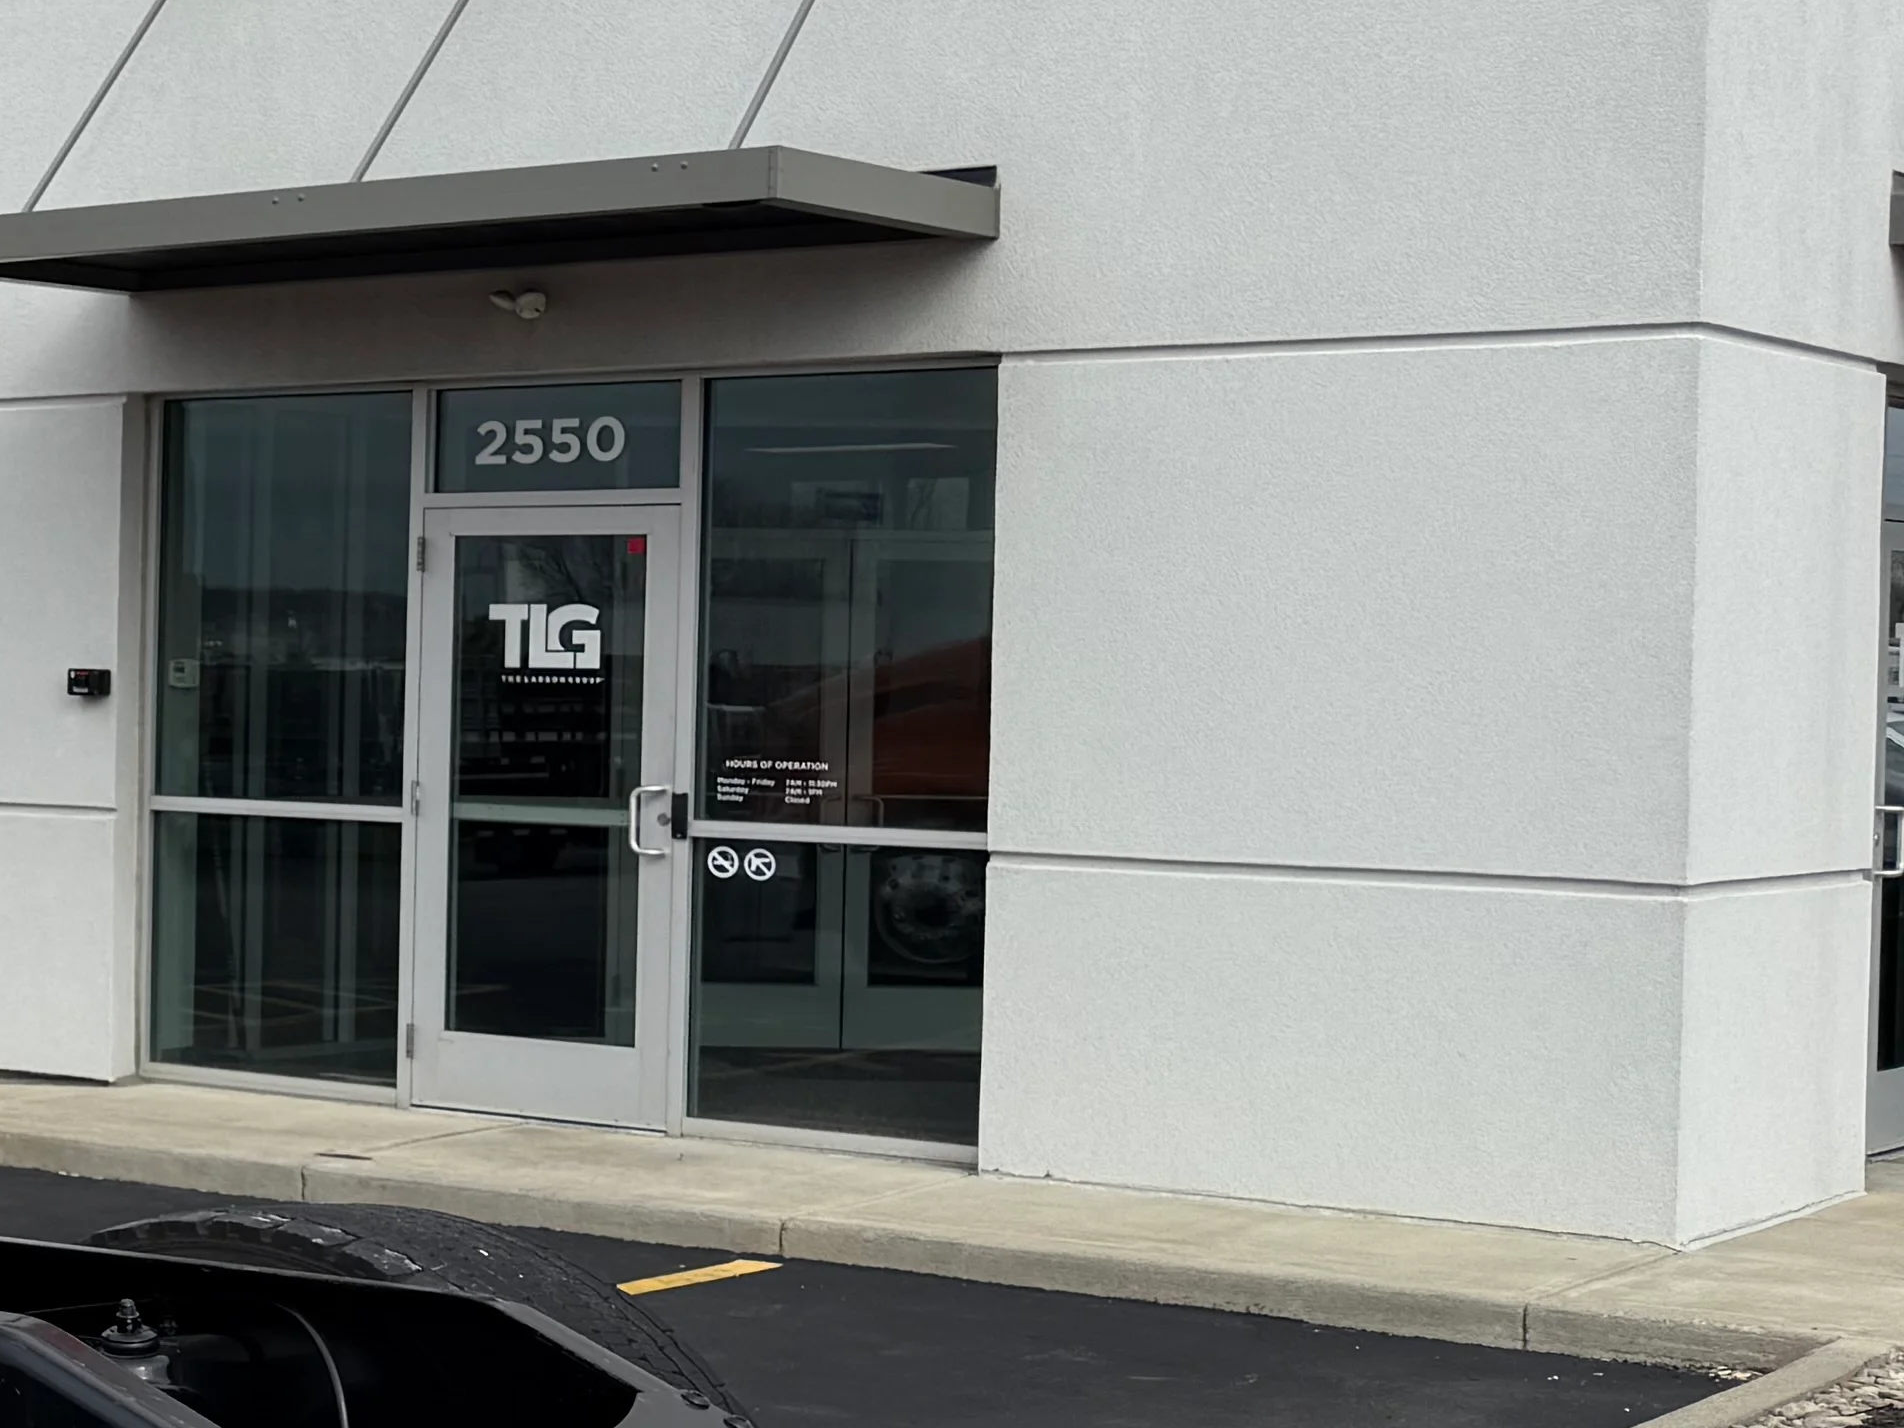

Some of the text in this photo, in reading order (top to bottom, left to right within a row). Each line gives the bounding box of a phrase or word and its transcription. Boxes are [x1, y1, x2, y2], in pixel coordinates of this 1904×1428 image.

[475, 416, 625, 465] 2550
[489, 603, 601, 669] TLG
[725, 760, 829, 771] HOURS OF OPERATION
